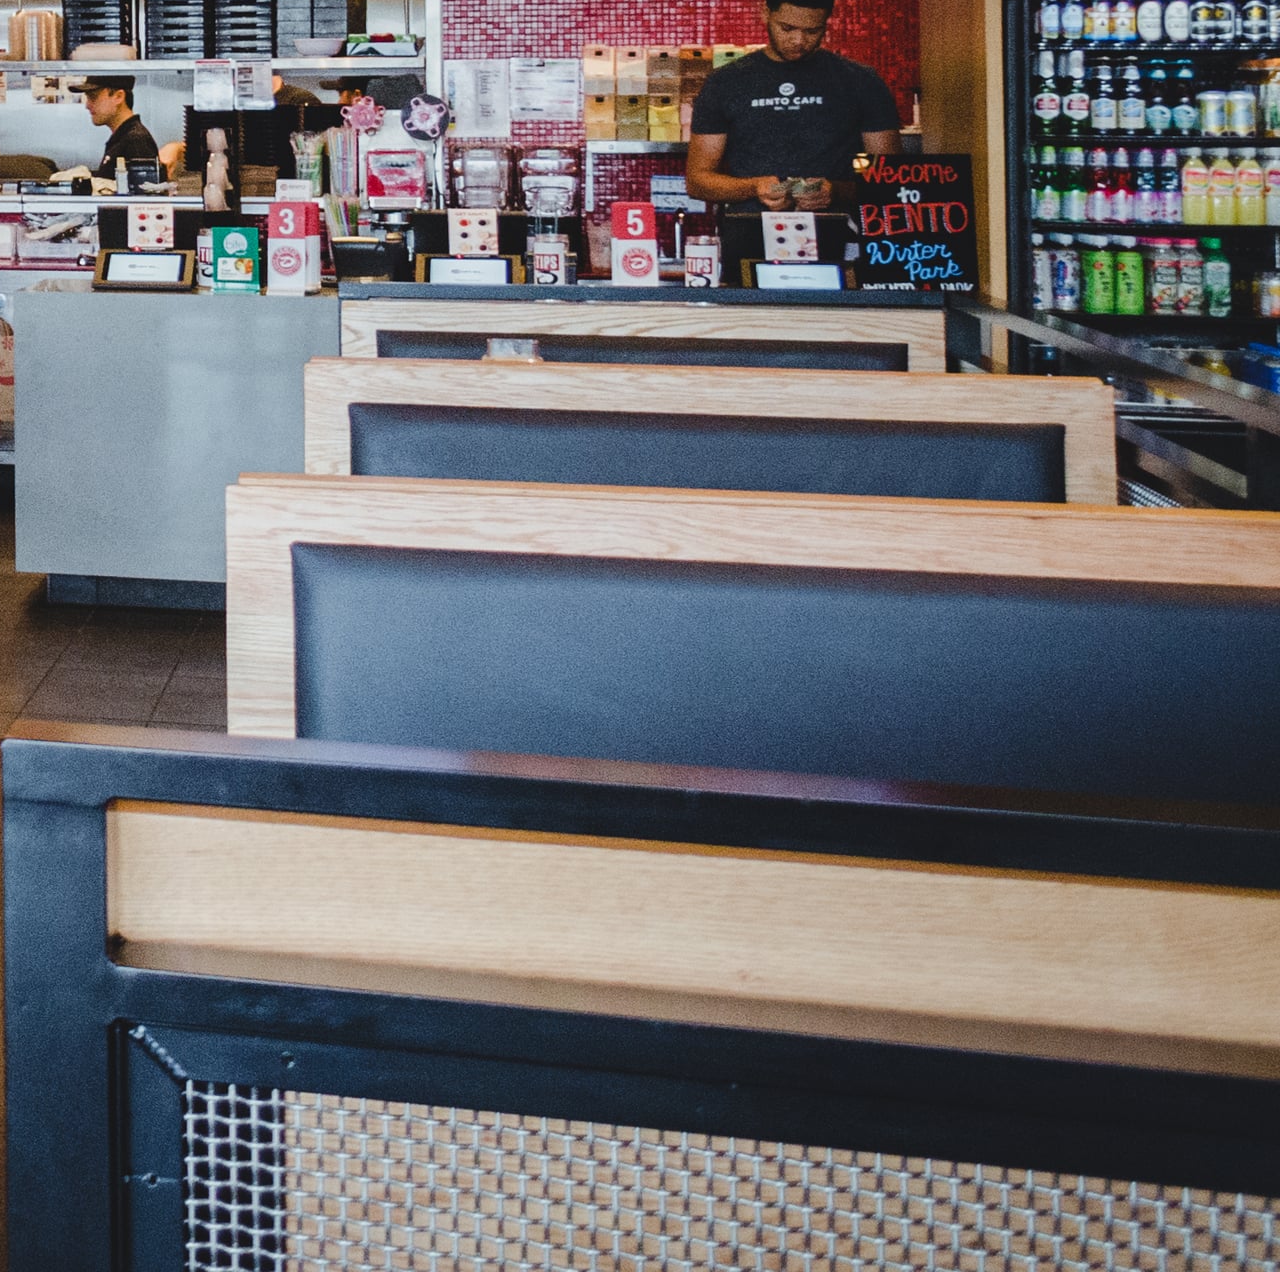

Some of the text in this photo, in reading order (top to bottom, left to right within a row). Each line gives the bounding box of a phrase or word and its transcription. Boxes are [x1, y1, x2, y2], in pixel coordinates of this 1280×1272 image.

[751, 96, 823, 107] BENTO CAFE
[896, 186, 921, 204] to
[278, 208, 295, 235] 3
[626, 209, 644, 236] 5
[860, 201, 969, 236] BENTO
[535, 254, 559, 271] TIPS
[866, 240, 952, 265] Winter
[687, 258, 712, 273] TIPS
[903, 259, 964, 281] Park
